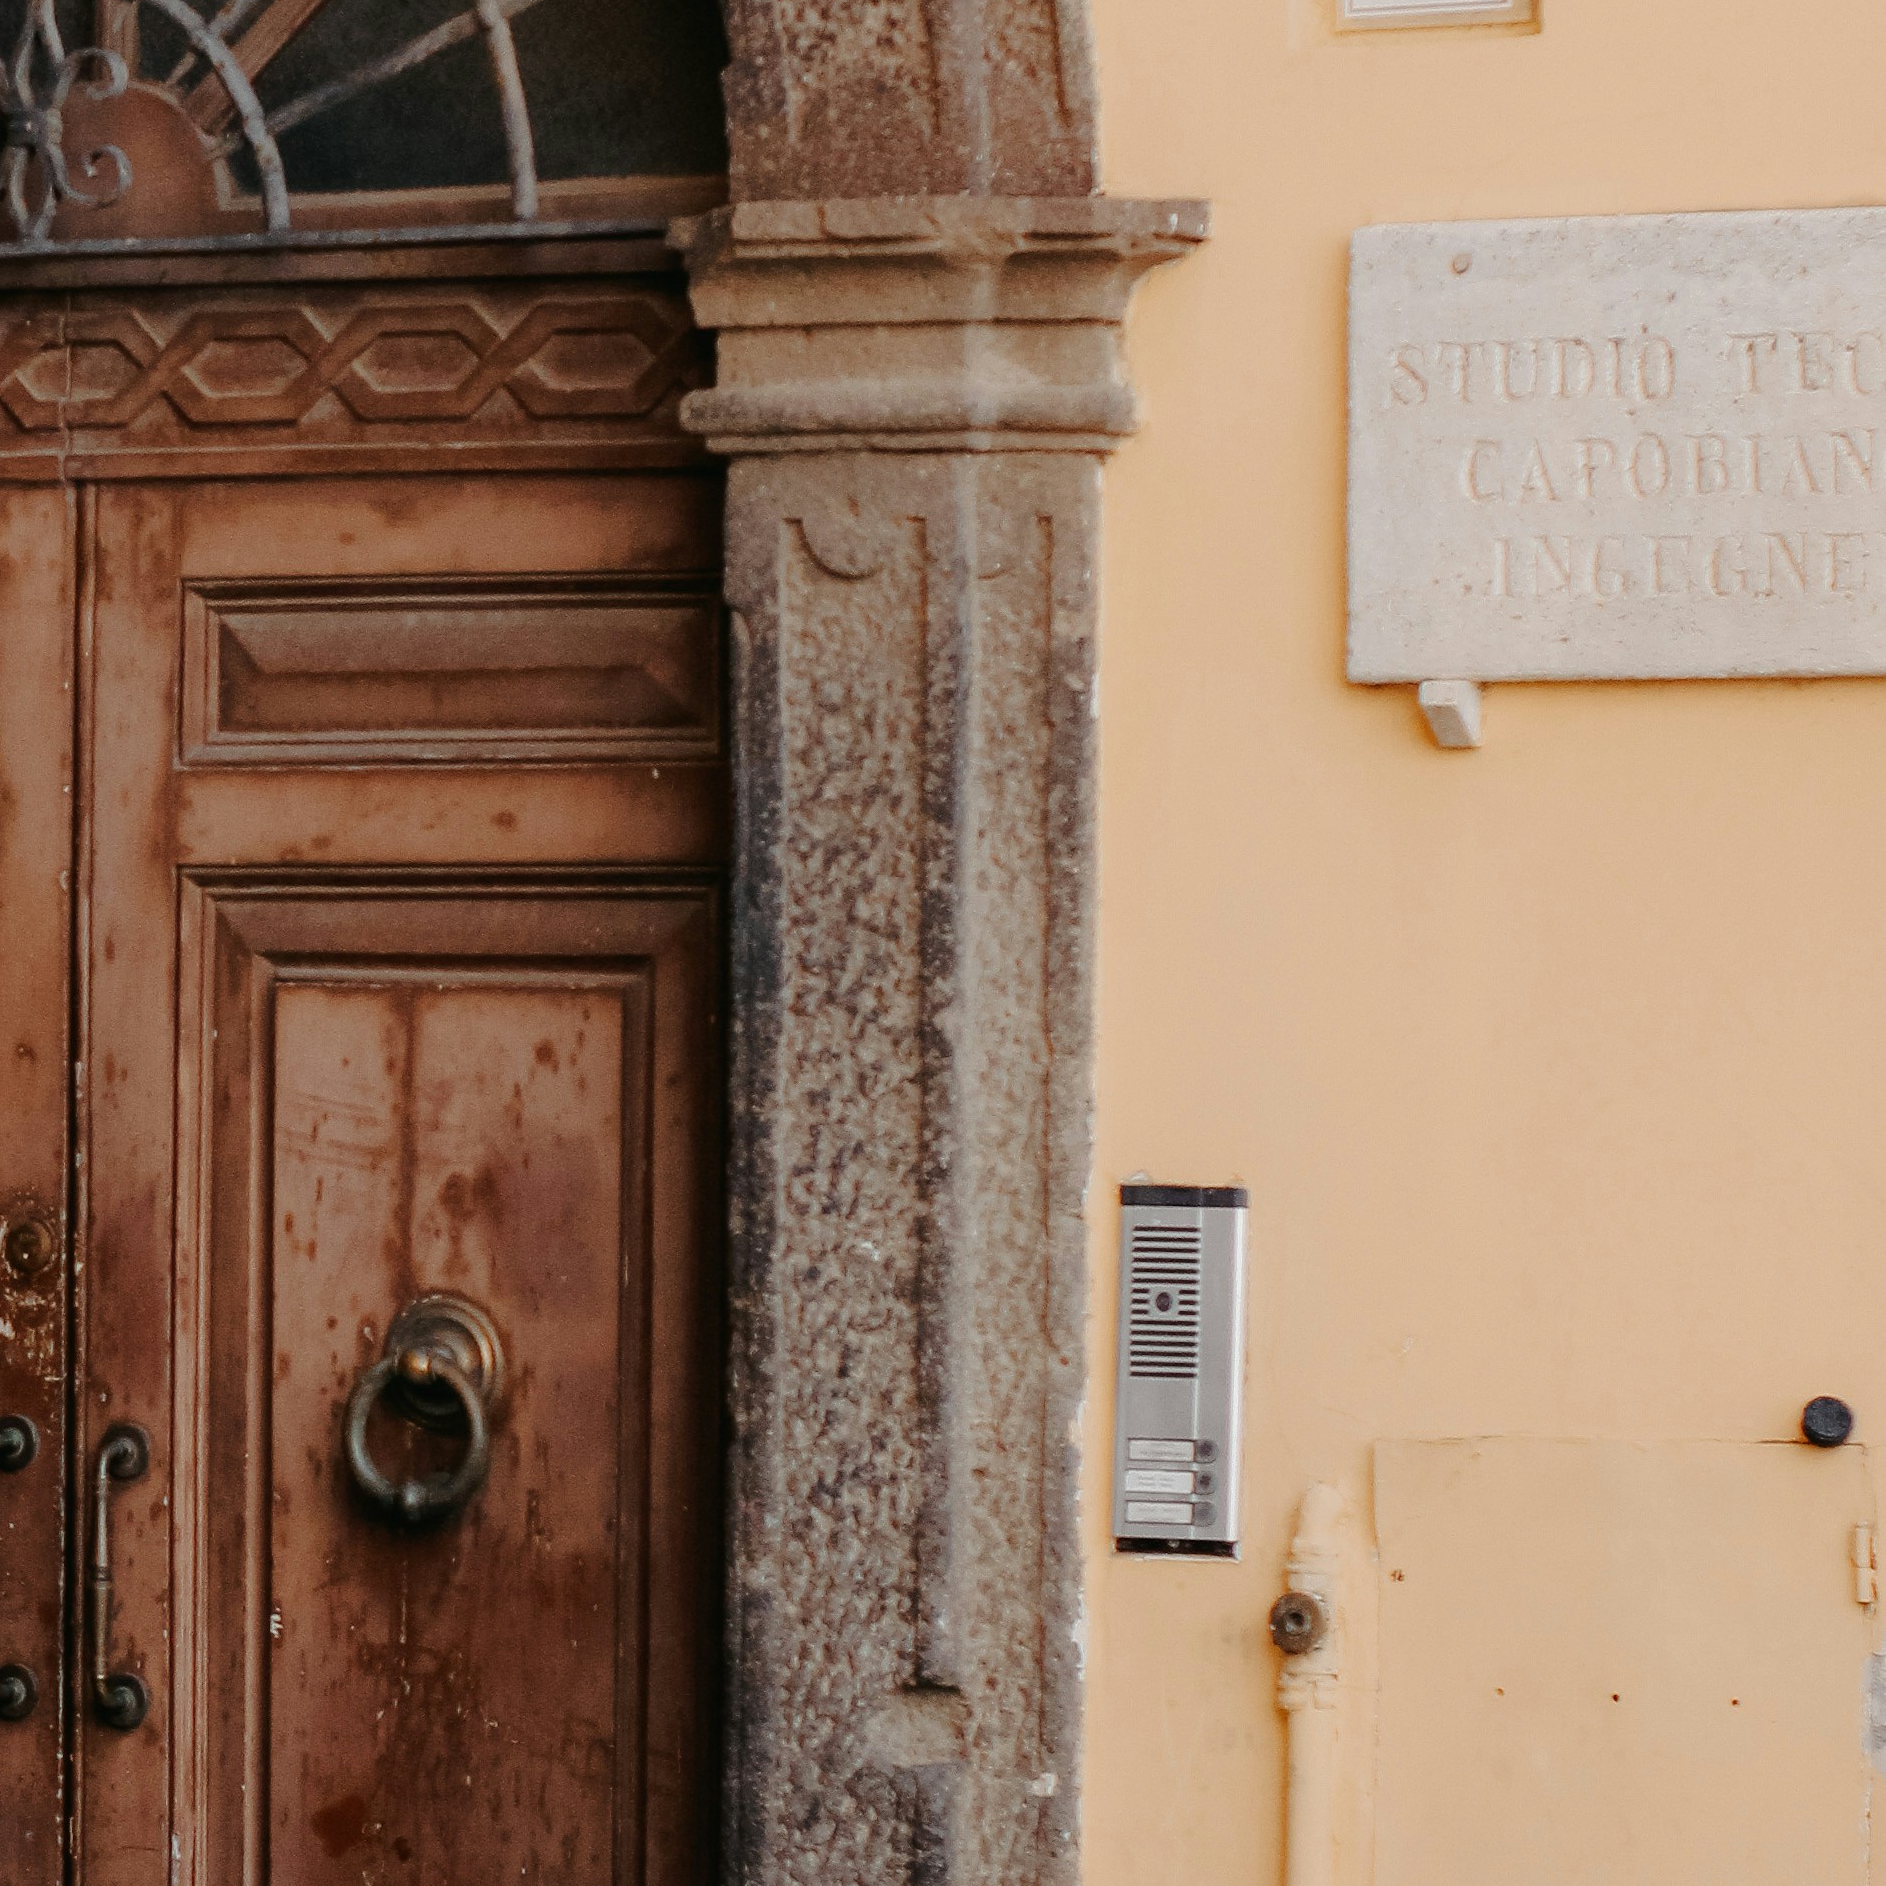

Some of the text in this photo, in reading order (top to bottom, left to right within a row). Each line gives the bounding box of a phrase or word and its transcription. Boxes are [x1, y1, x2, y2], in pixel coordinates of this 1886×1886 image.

[1386, 331, 1676, 405] STUDIO
[1464, 429, 1877, 504] CAPOBIAN
[1492, 528, 1886, 598] INGEGNE
